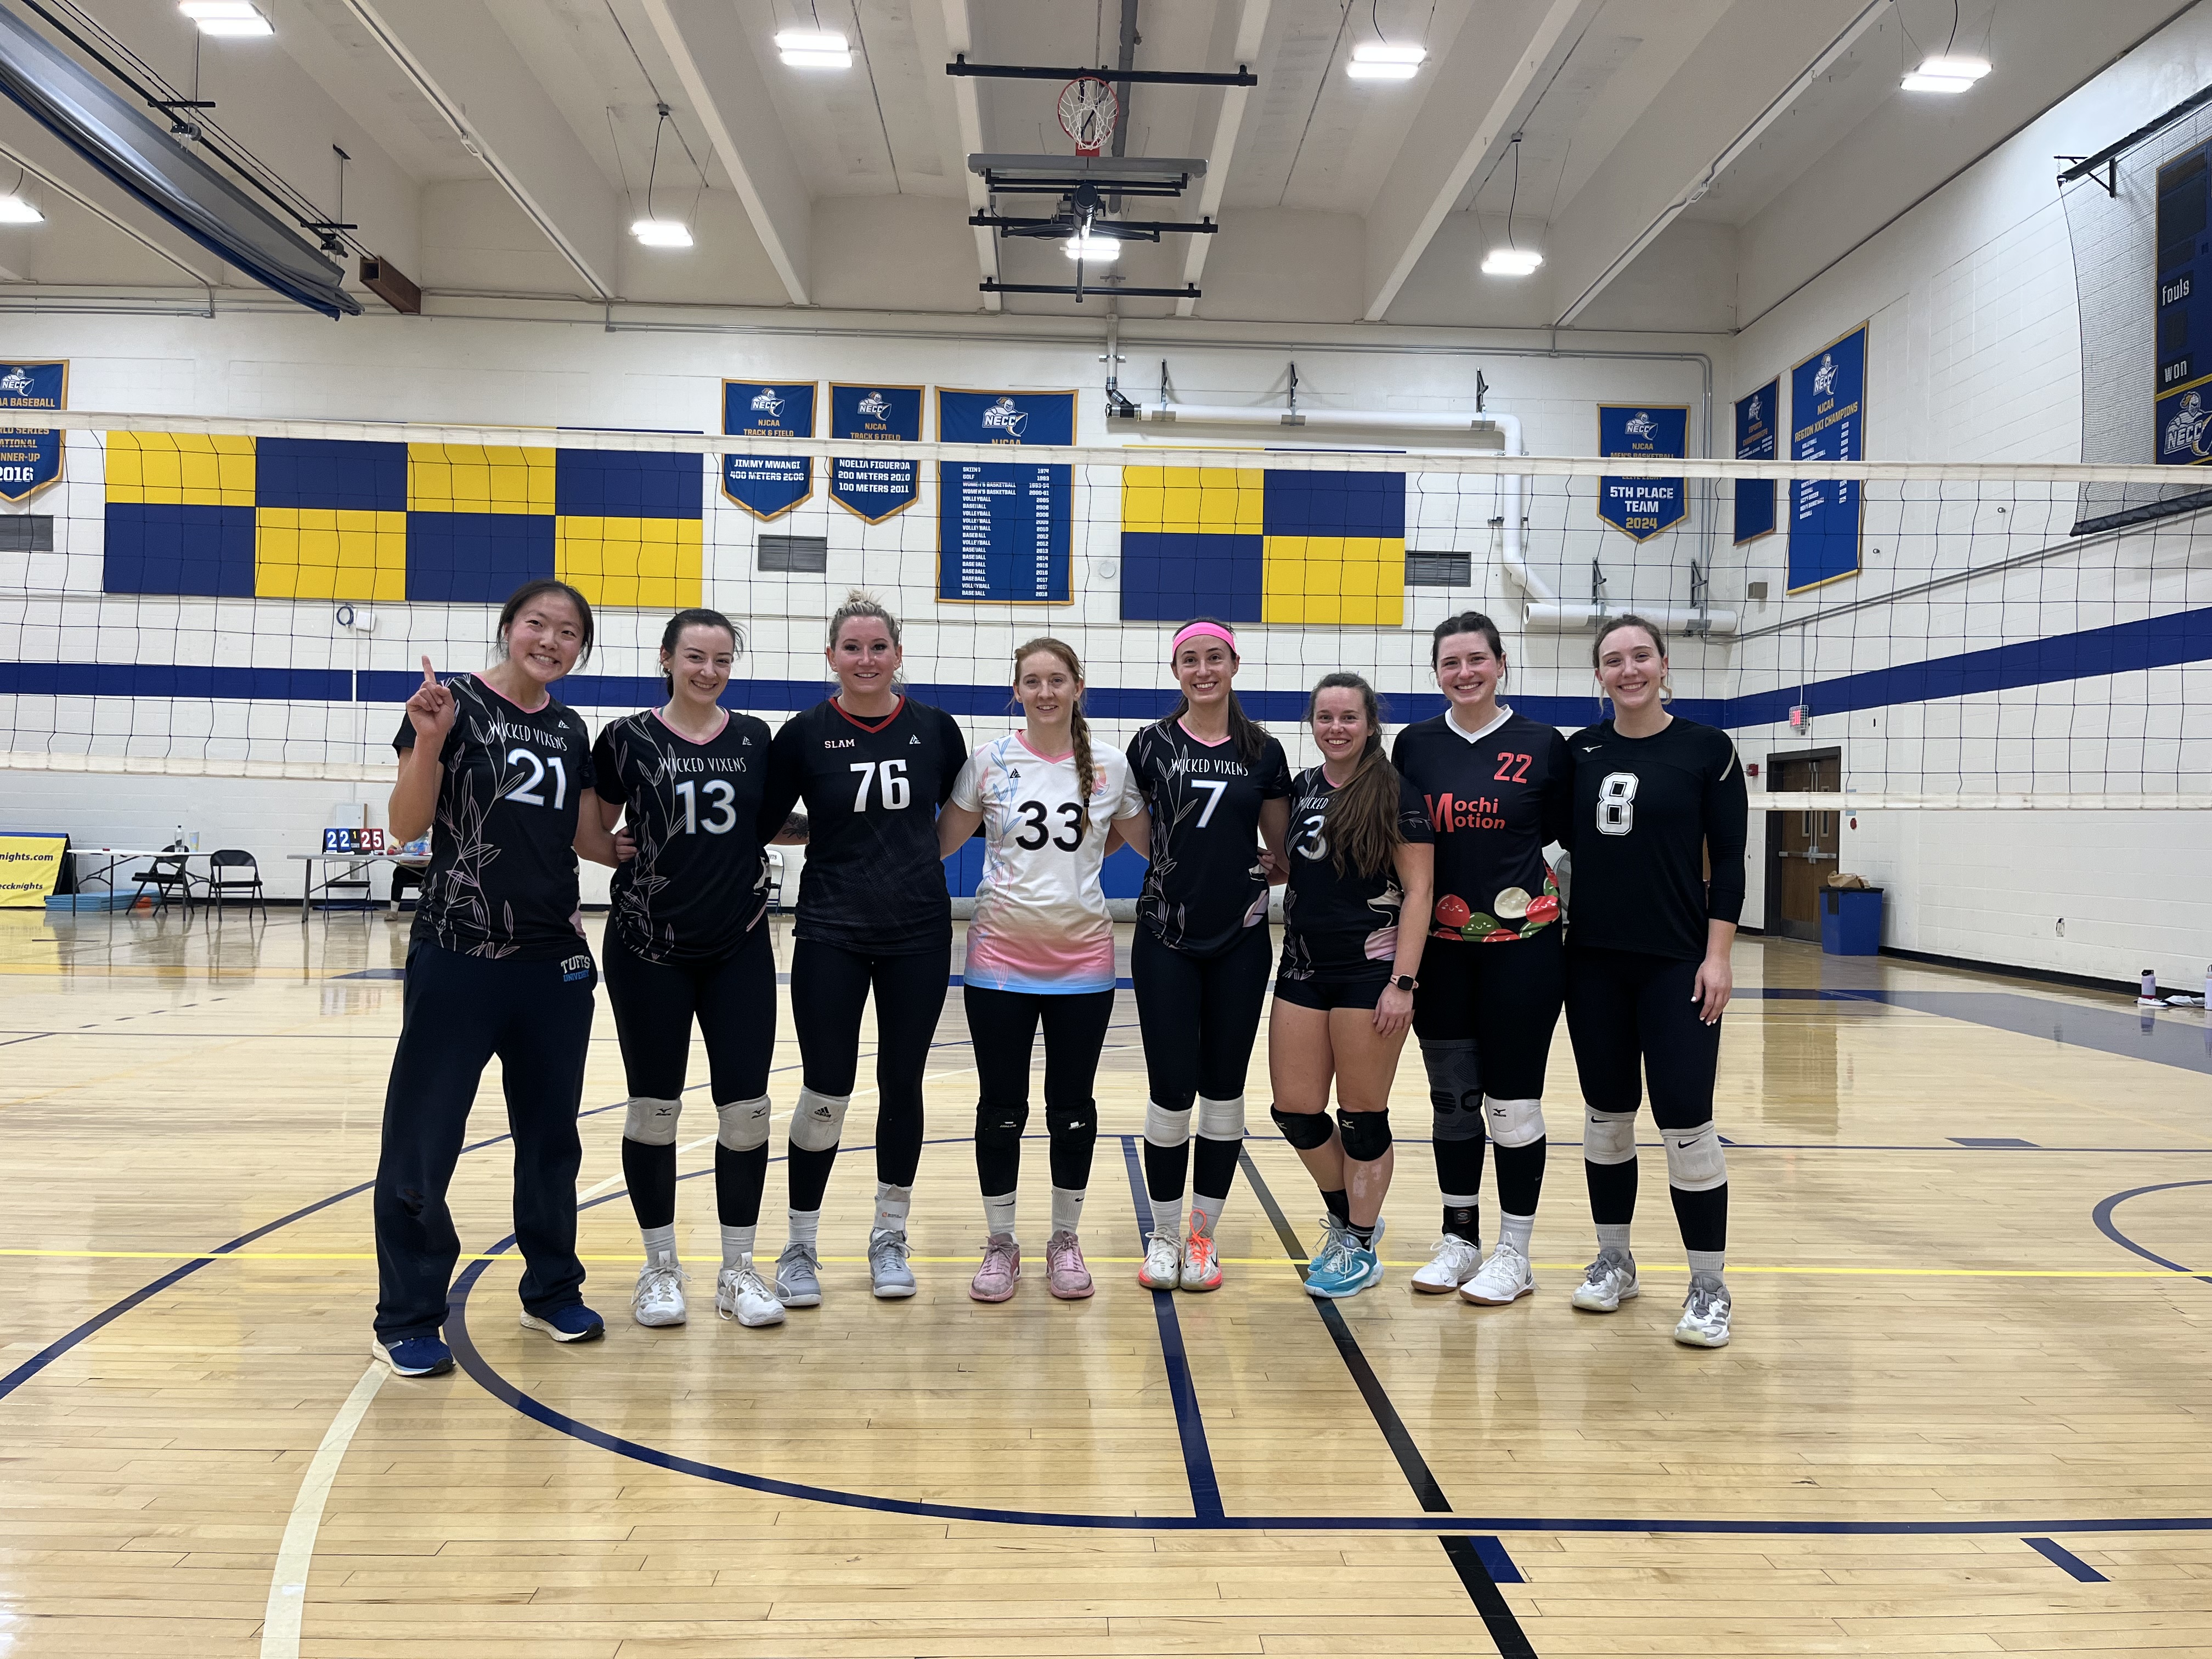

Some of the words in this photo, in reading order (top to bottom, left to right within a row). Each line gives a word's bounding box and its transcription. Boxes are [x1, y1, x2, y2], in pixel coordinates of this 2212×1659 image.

[2162, 279, 2190, 306] fouls
[2164, 360, 2187, 383] won
[2, 381, 25, 389] NECC
[1814, 373, 1833, 392] NECC
[10, 398, 55, 407] BASEBALL
[752, 401, 776, 409] NECC
[860, 404, 884, 413] NECC
[1818, 397, 1834, 415] NJCAA
[984, 415, 1016, 426] NECC
[1795, 424, 1814, 443] REGION
[1814, 419, 1824, 433] XXI
[1825, 401, 1858, 428] CHAMPIONS
[2167, 420, 2203, 450] NECC
[734, 459, 764, 469] JIMMY
[765, 460, 800, 469] MWANGI
[839, 459, 868, 469] NOELIA
[870, 461, 910, 470] FIGUEROA
[730, 471, 747, 479] 400
[748, 471, 782, 481] METERS
[838, 471, 854, 479] 200
[856, 472, 889, 481] METERS
[839, 482, 854, 492] 100
[856, 484, 889, 493] METERS
[890, 485, 909, 493] 2011
[1610, 487, 1634, 499] 5TH
[1637, 487, 1673, 499] PLACE
[1624, 500, 1659, 513] TEAM
[1626, 517, 1658, 529] 2024
[488, 720, 531, 742] WICKED
[533, 728, 568, 752] VIXENS
[825, 738, 855, 749] SLAM
[658, 757, 704, 772] WICKED
[707, 757, 747, 772] VIXENS
[1171, 758, 1210, 773] WICKED
[1214, 759, 1249, 776] VIXENS
[1493, 752, 1533, 784] 22
[505, 748, 567, 810] 21
[850, 759, 911, 812] 76
[675, 779, 737, 835] 13
[1191, 779, 1228, 828] 7
[1298, 796, 1329, 810] WICKED
[1596, 772, 1639, 836] 8
[1015, 800, 1084, 852] 33
[327, 831, 349, 848] 22
[361, 831, 382, 848] 25
[1296, 815, 1328, 860] 3
[561, 955, 591, 974] TUFTS
